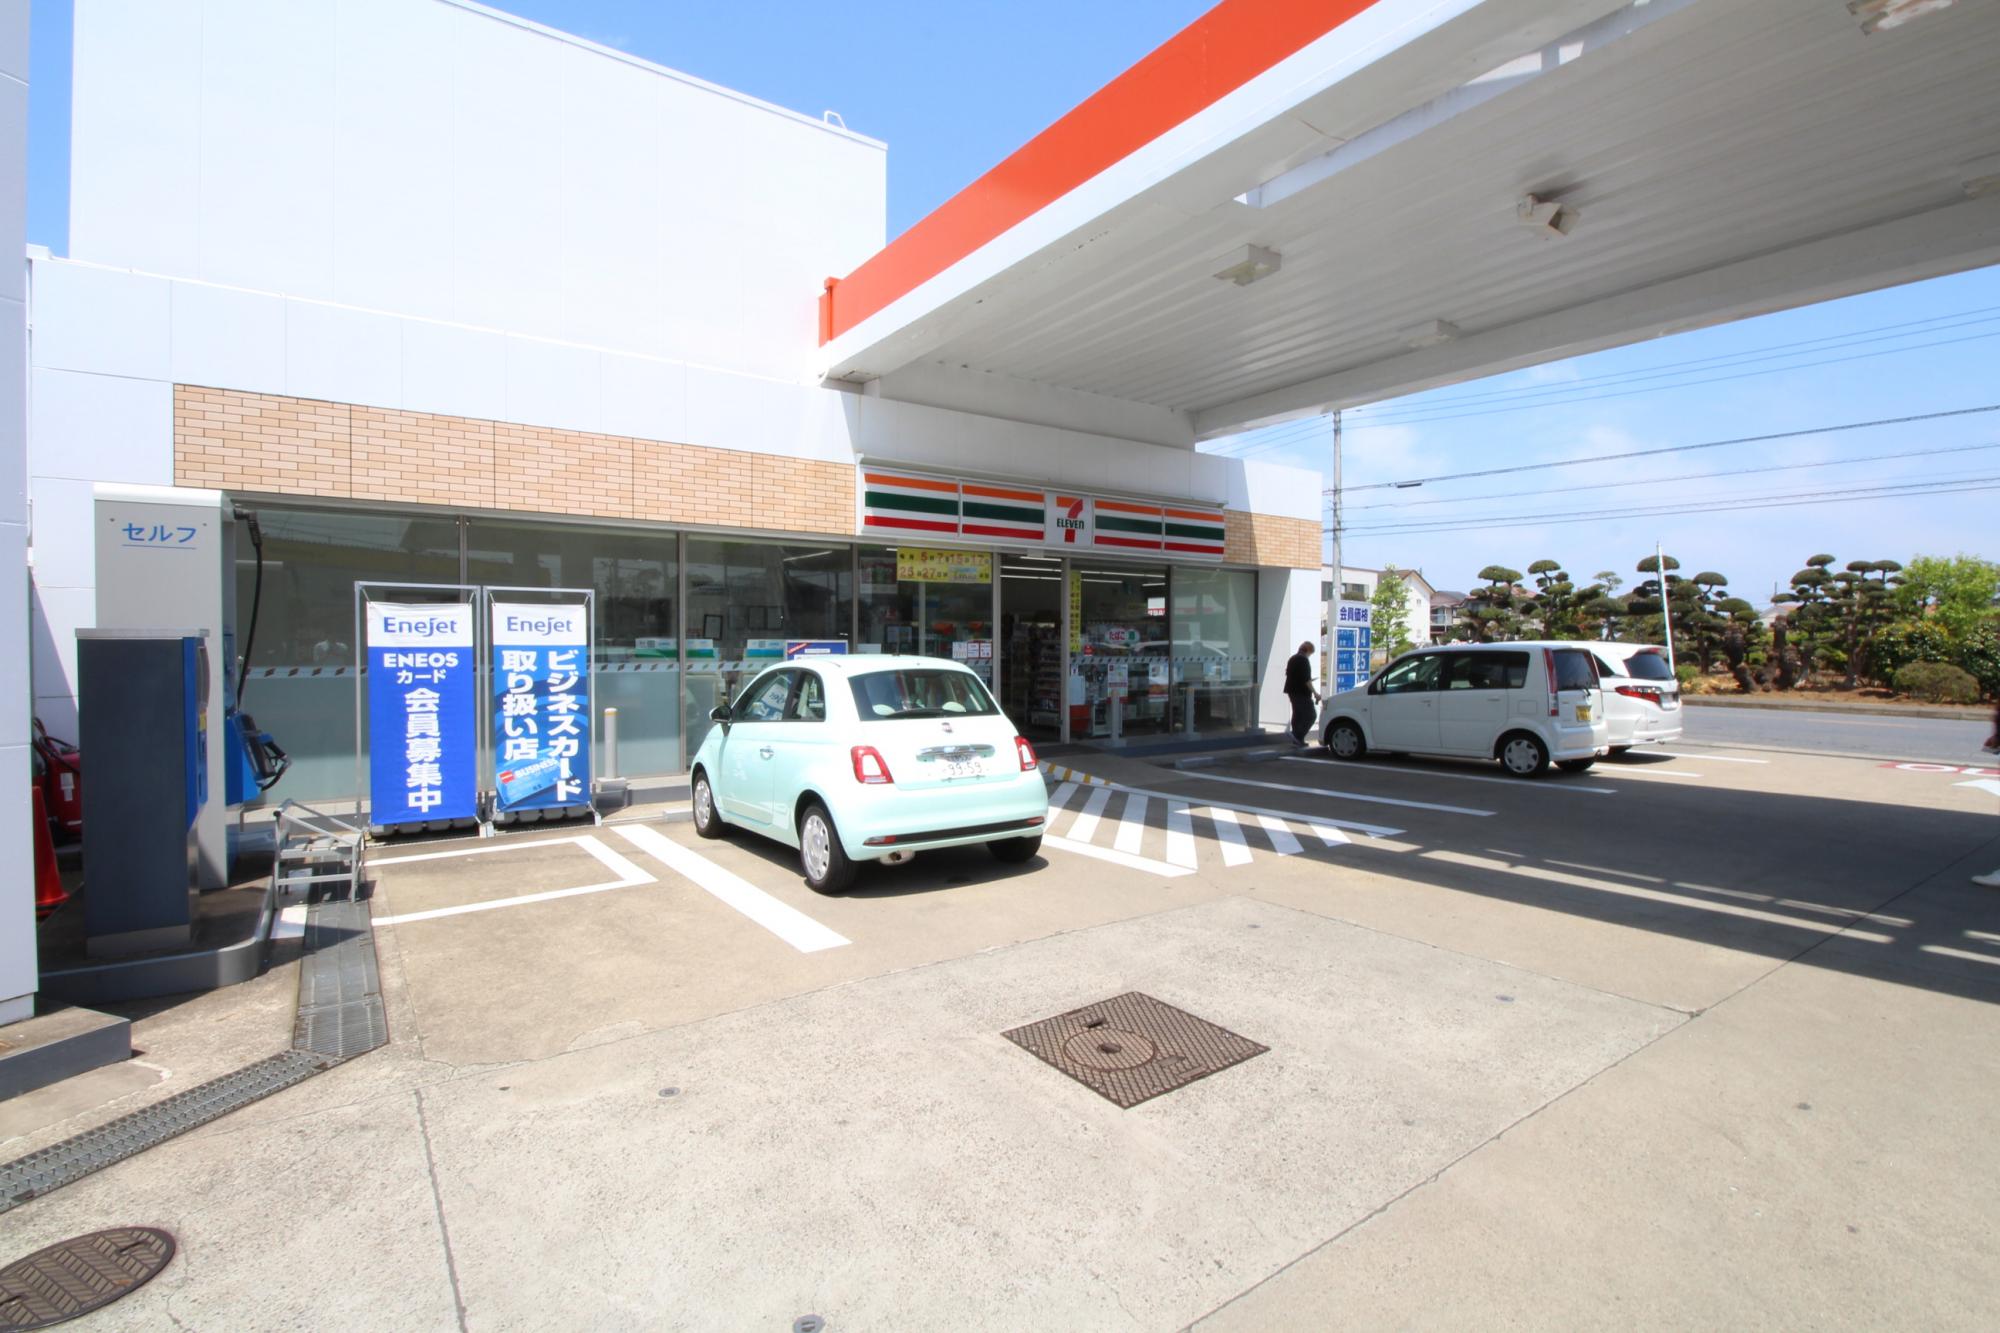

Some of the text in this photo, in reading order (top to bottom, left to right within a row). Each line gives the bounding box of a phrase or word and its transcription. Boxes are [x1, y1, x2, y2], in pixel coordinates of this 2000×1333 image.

[1056, 496, 1084, 543] 7
[122, 523, 197, 543] セルフ
[1340, 606, 1369, 622] 会員価格
[383, 616, 458, 637] Enejet
[507, 616, 573, 636] Enejet
[383, 653, 458, 667] ENEOS
[397, 669, 446, 684] カード
[502, 650, 538, 760] 取り扱い店
[547, 650, 581, 801] ビジネスカード
[404, 687, 442, 813] 会員募集中
